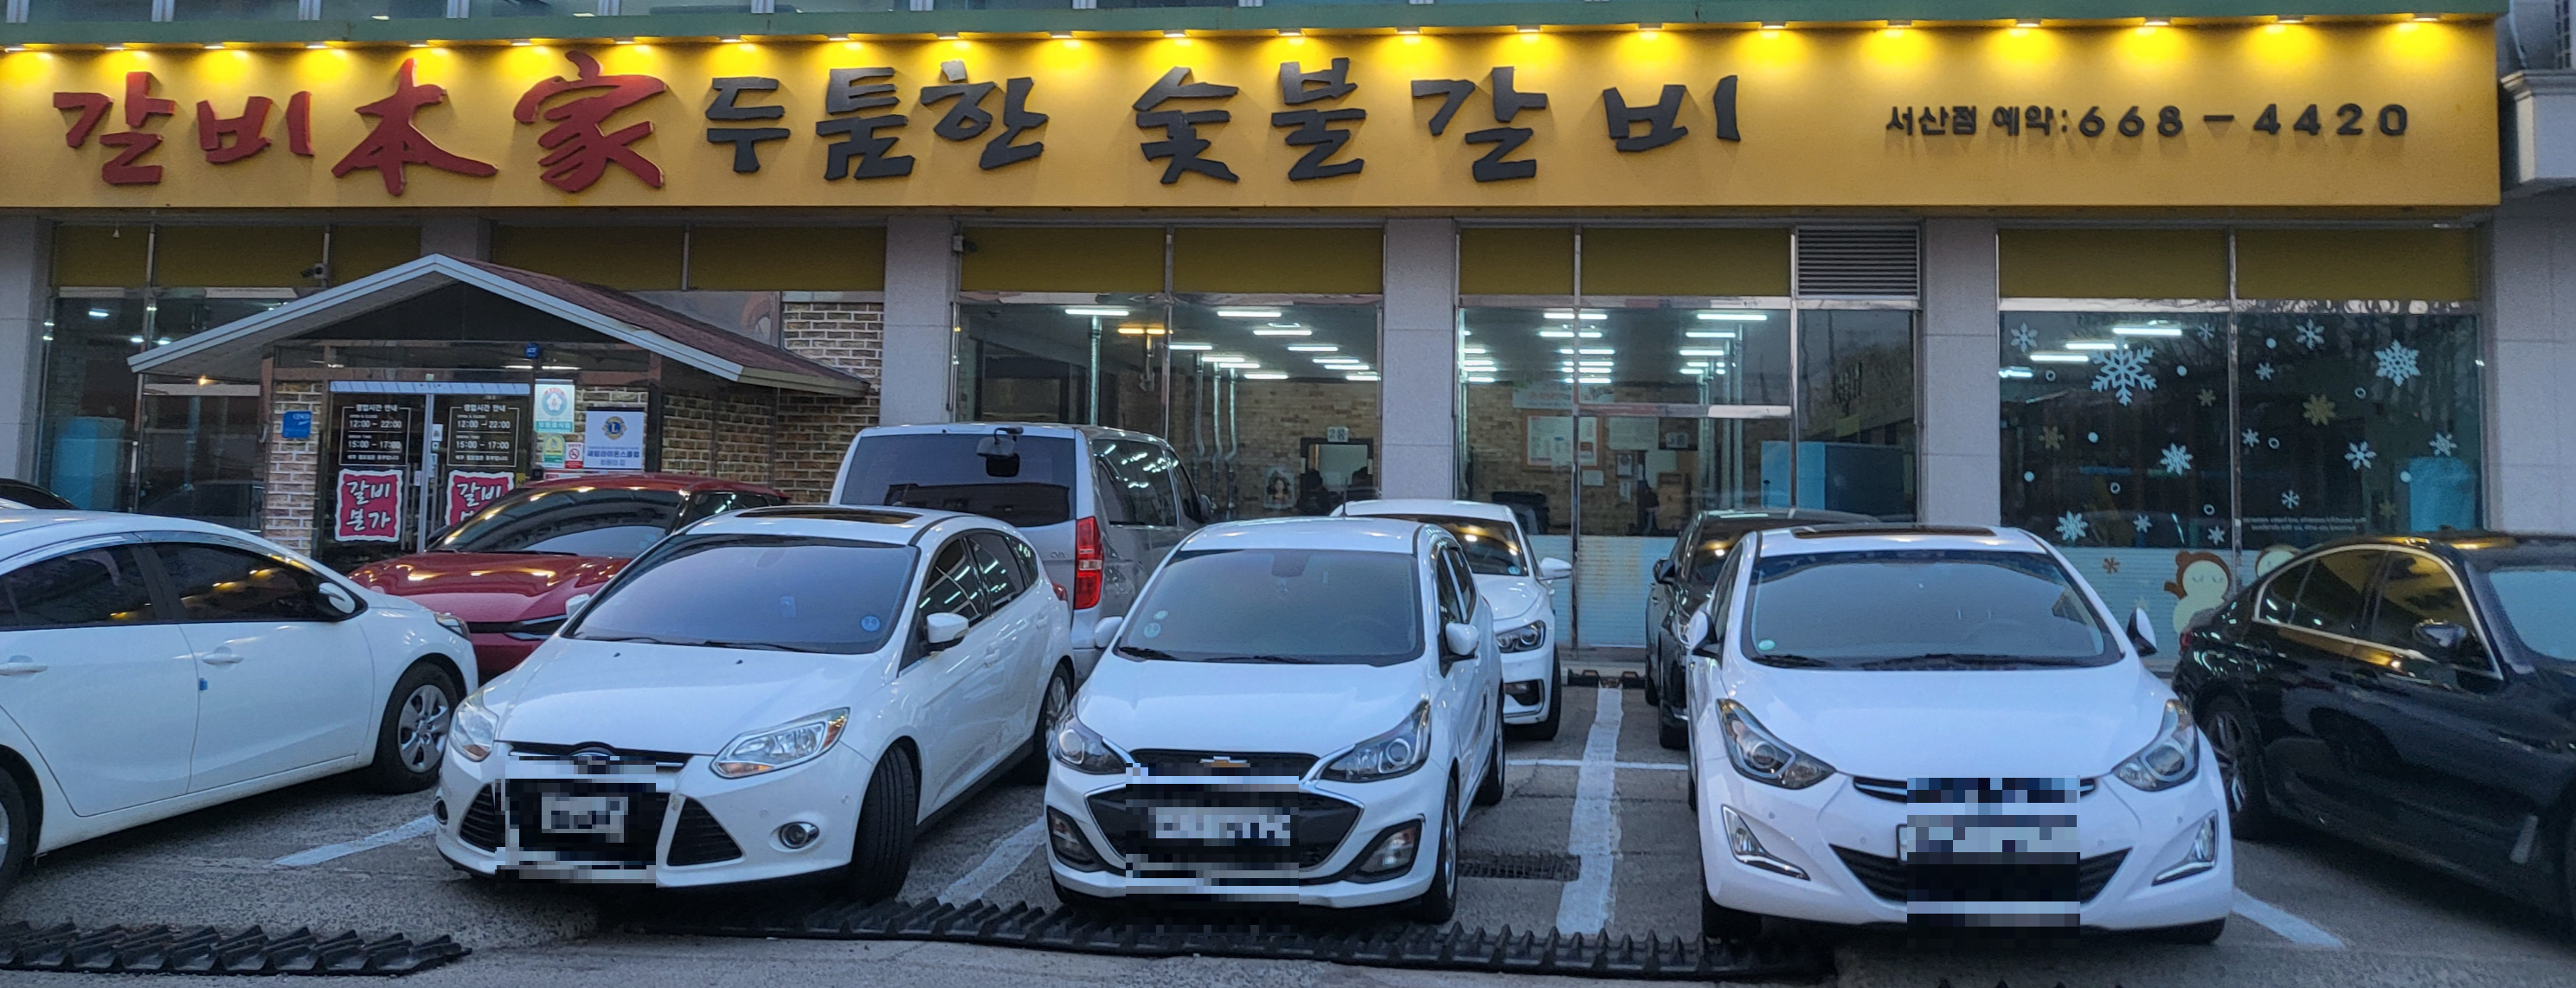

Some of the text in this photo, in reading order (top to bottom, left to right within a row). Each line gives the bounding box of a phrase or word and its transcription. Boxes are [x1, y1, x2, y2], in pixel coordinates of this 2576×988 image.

[704, 59, 1050, 182] 두툼한
[1885, 105, 1977, 138] 서산점
[356, 403, 382, 412] 영업시간
[463, 403, 506, 413] 영업시간 안내
[349, 420, 370, 428] 12:00
[457, 420, 479, 428] 12:00
[379, 440, 401, 449] 17:00
[456, 440, 478, 449] 15:00
[346, 479, 391, 505] 갈비
[456, 481, 502, 507] 갈비
[345, 508, 391, 531] 불가
